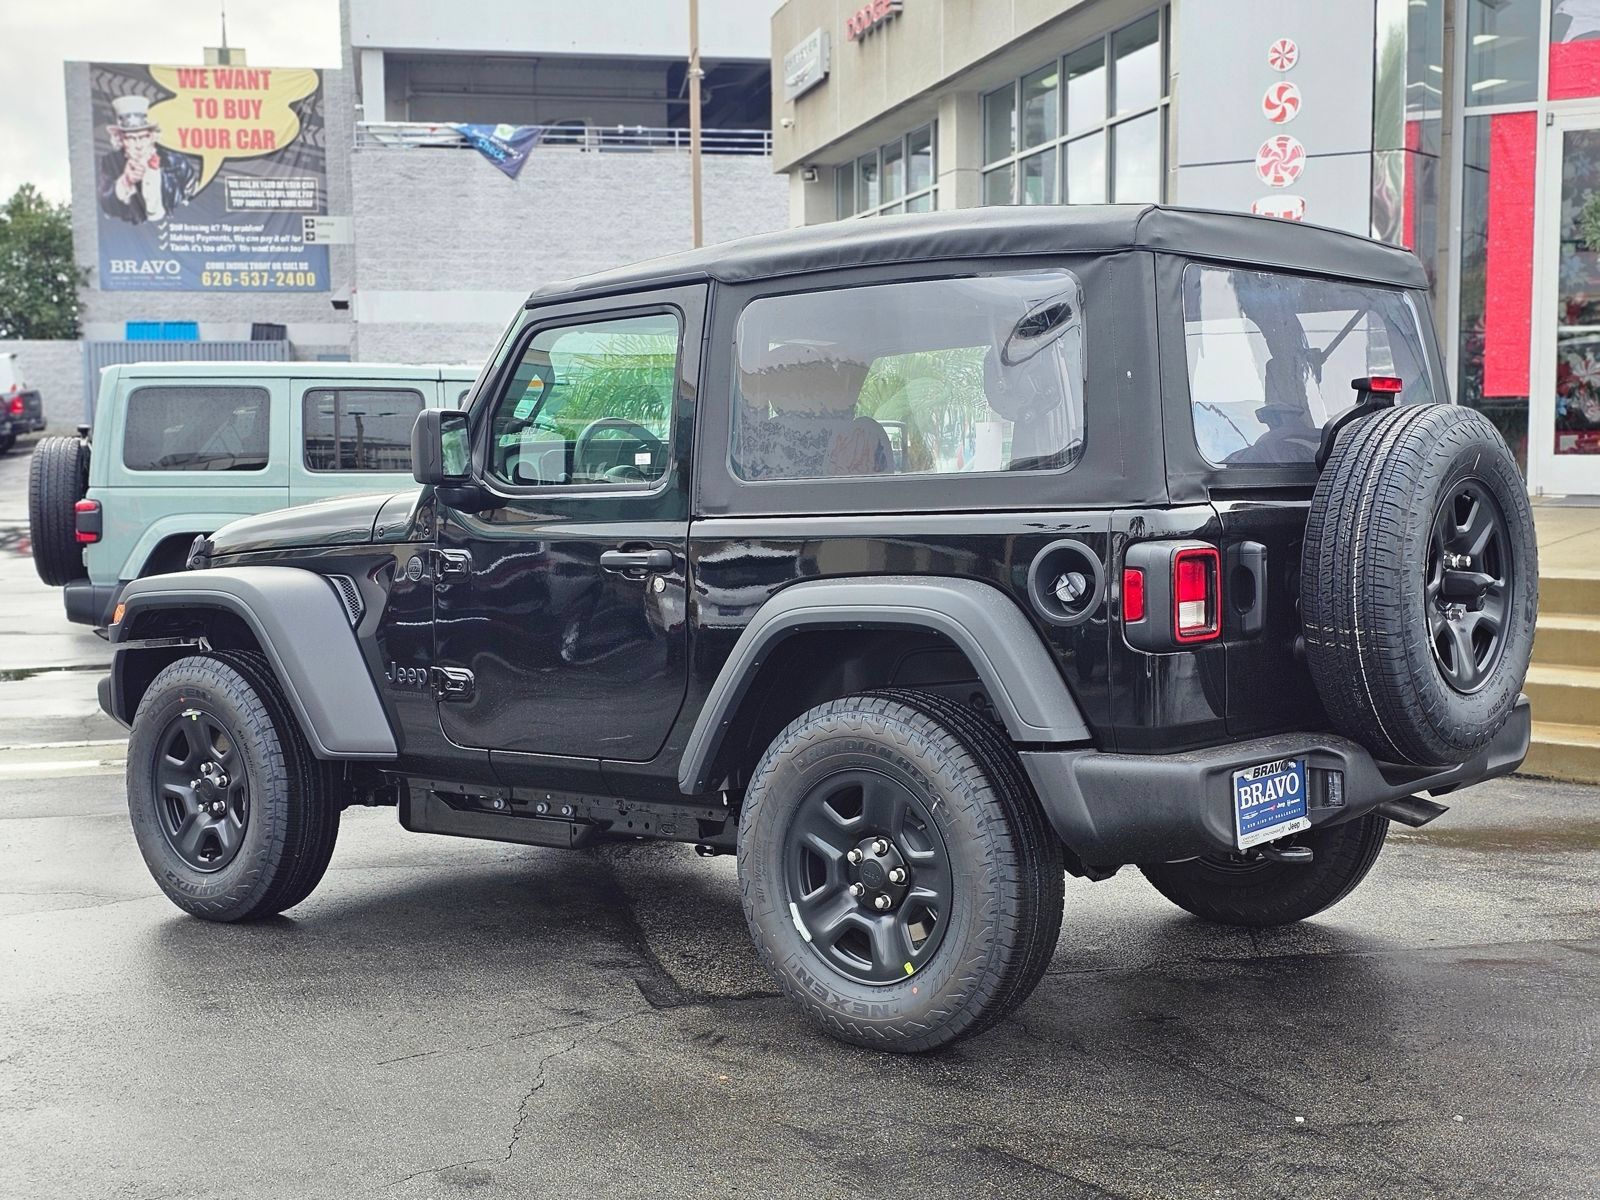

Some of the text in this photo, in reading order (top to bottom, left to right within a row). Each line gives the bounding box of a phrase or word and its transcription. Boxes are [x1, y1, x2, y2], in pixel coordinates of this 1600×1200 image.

[177, 68, 272, 91] WE WANT
[193, 98, 263, 121] TO BUY
[178, 127, 276, 150] YOUR CAR
[110, 259, 181, 274] BRAVO
[202, 271, 316, 287] 626-537-2400
[385, 661, 428, 689] Jeep
[1253, 759, 1290, 779] BRAVO
[1239, 772, 1300, 810] BRAVO
[1287, 821, 1300, 831] Jeep
[795, 966, 890, 1018] NEXEN
